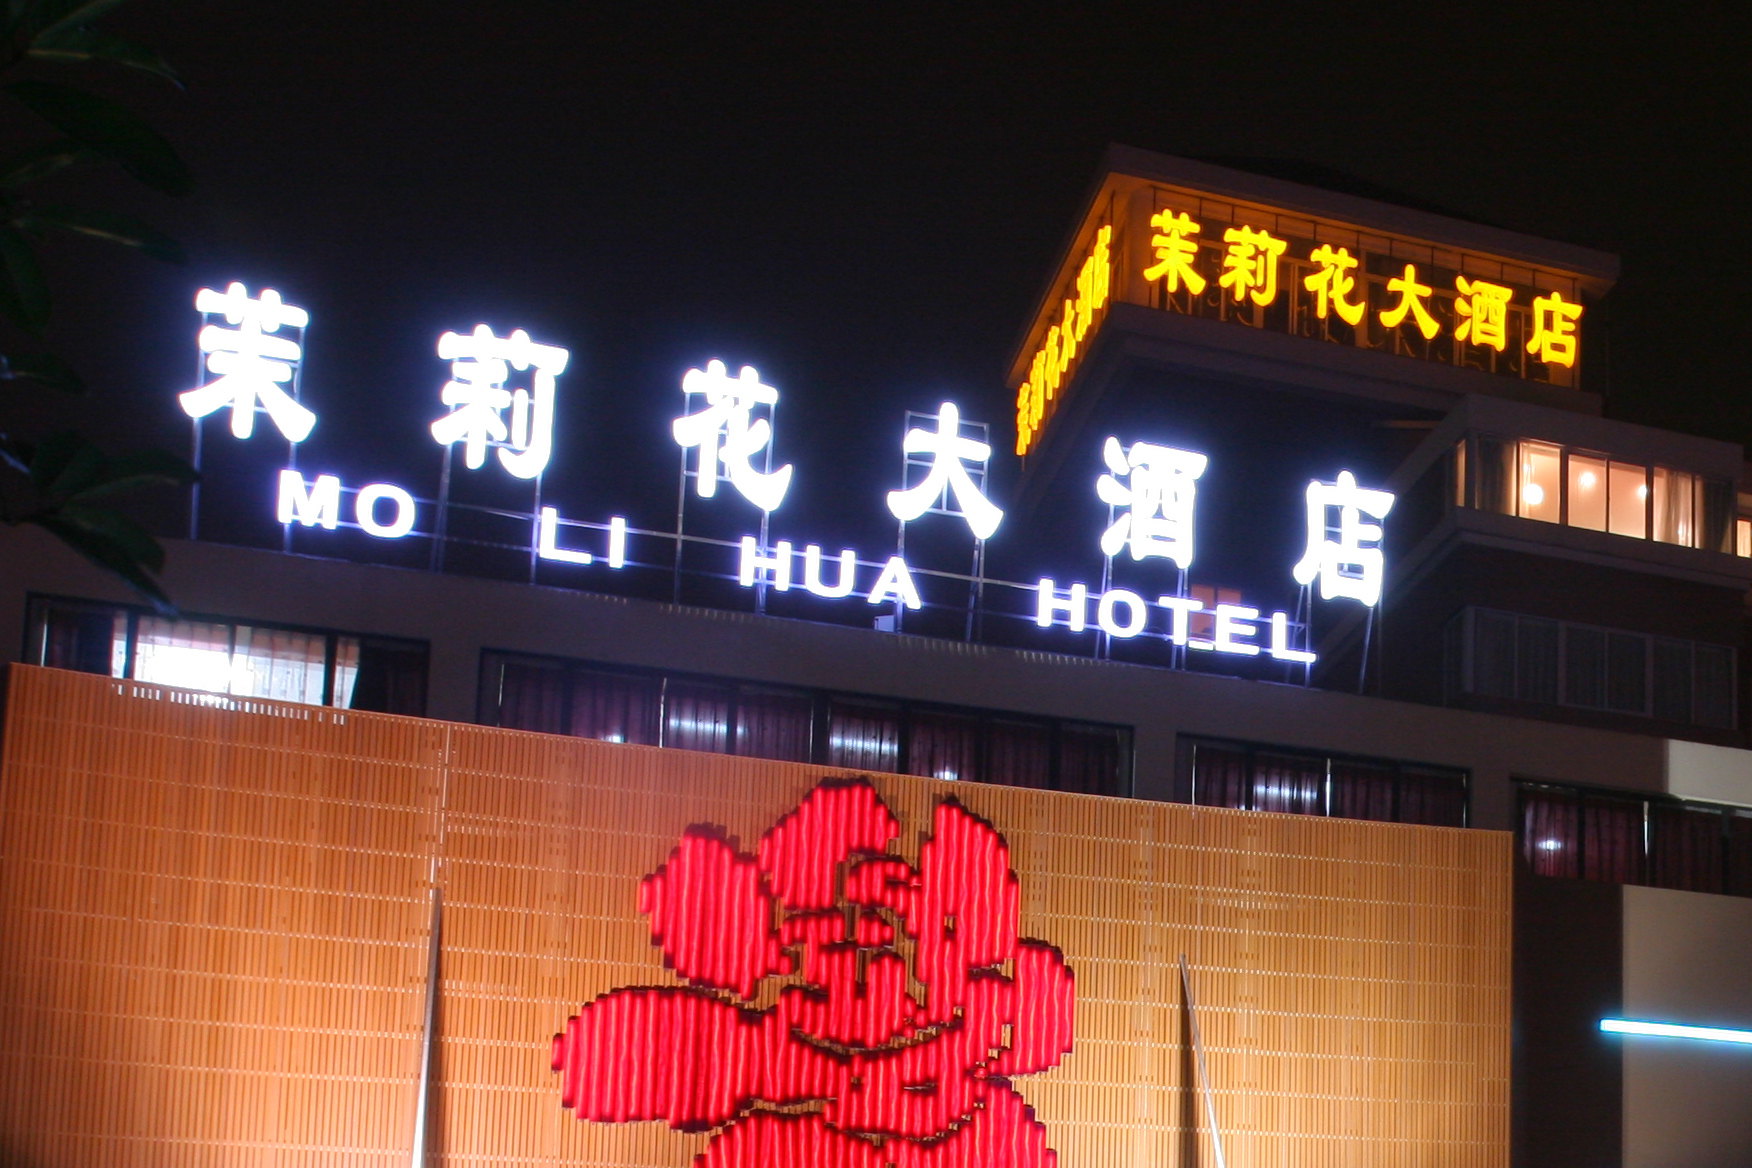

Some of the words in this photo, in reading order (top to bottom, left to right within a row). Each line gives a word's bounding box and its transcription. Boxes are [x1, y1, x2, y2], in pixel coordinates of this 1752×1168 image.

[1142, 208, 1584, 369] 茉莉花大酒店
[179, 281, 1395, 606] 茉莉花大酒店
[276, 469, 417, 539] MO
[538, 506, 626, 569] LI
[738, 535, 923, 610] HUA
[1036, 578, 1318, 664] HOTEL
